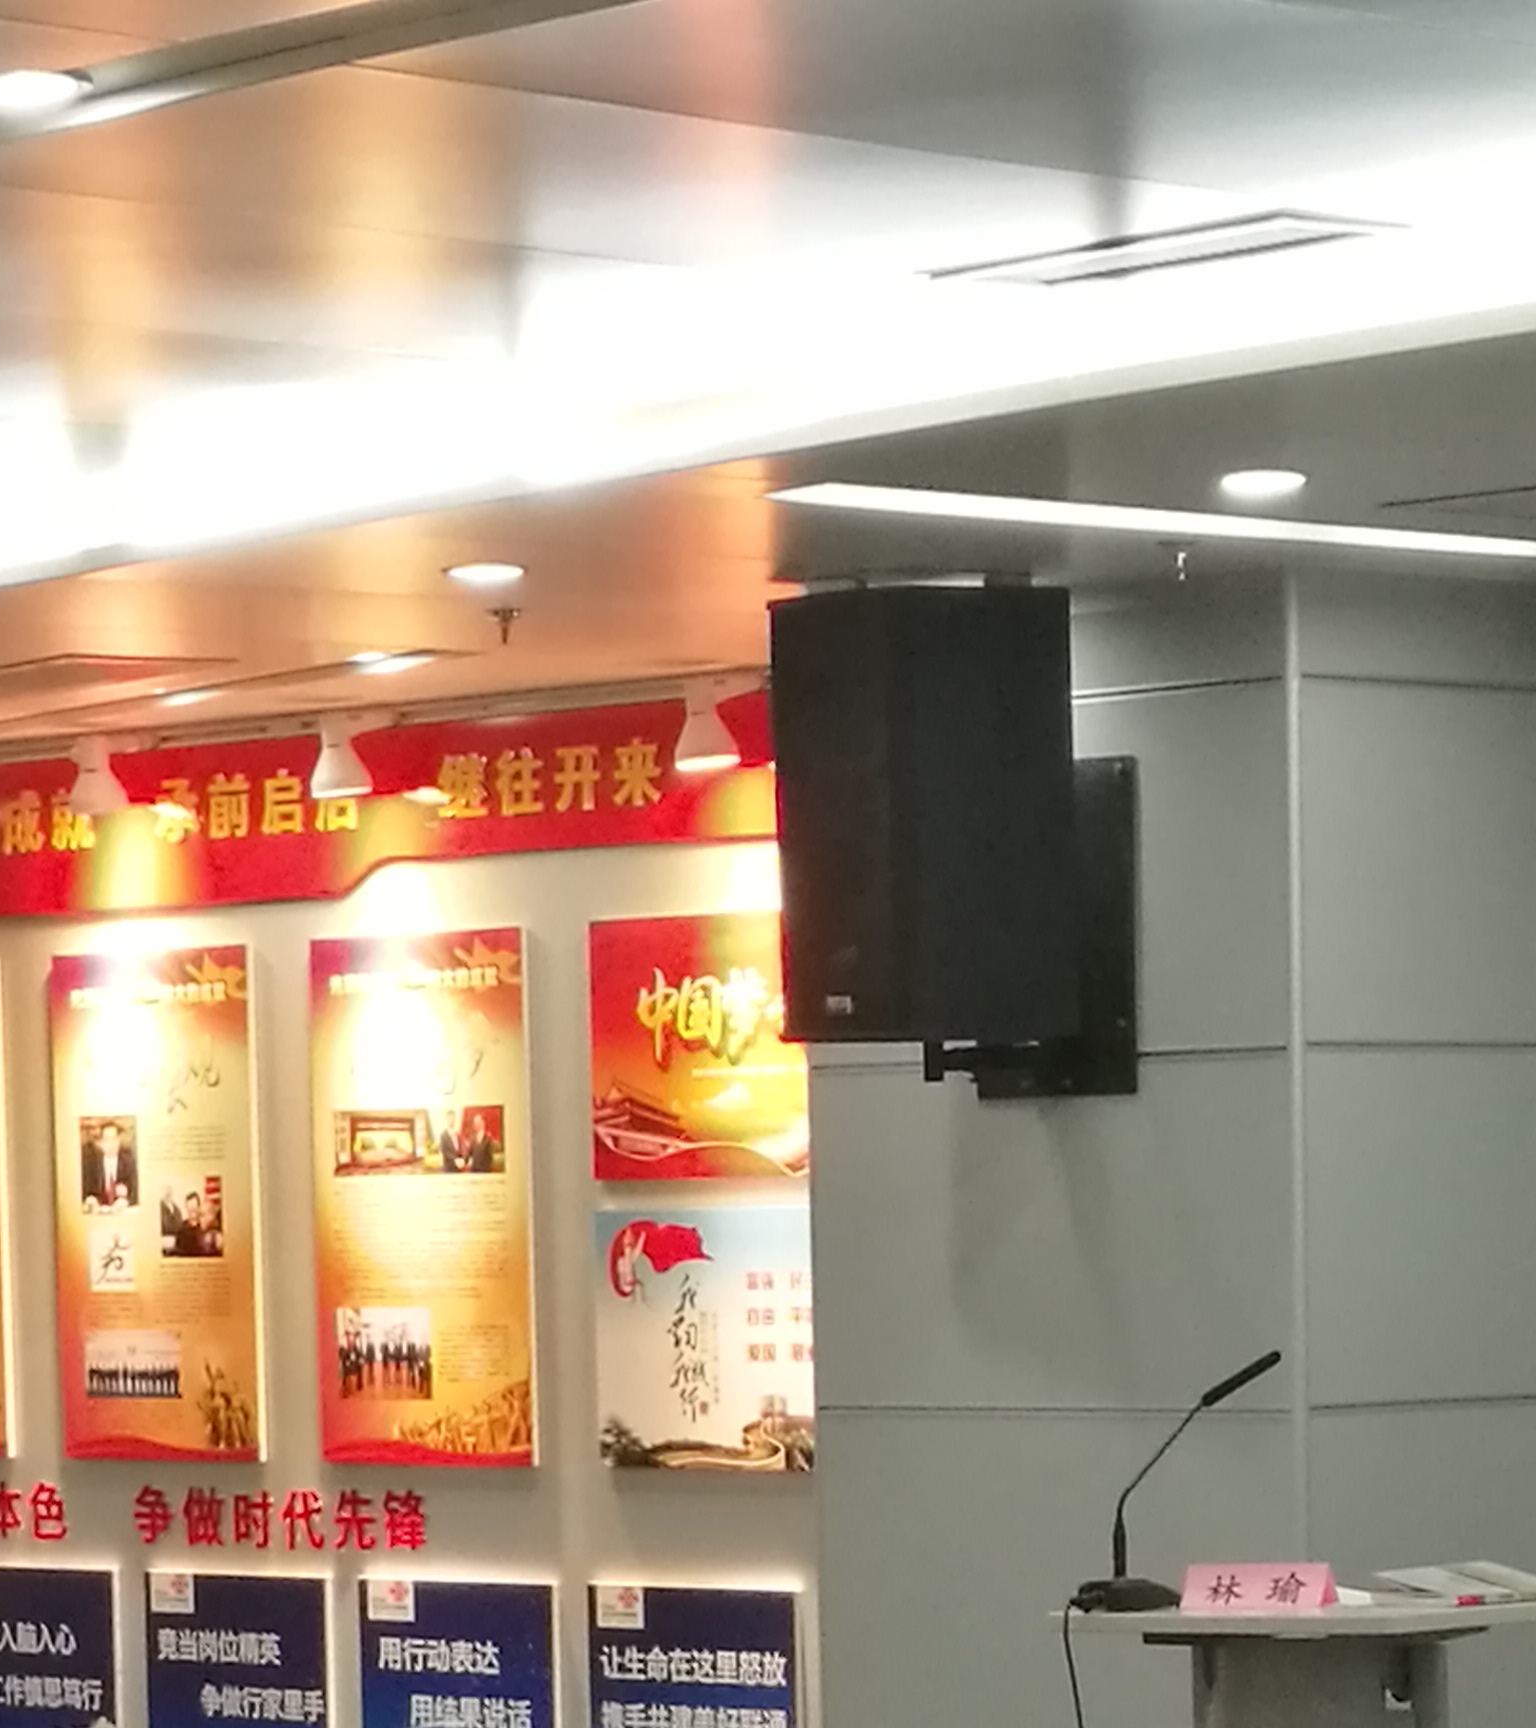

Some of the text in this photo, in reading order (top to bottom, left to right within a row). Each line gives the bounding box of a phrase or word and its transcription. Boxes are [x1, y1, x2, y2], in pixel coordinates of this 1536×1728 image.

[436, 737, 662, 818] 继往开来
[132, 1485, 428, 1552] 争做时代先锋
[157, 1627, 282, 1667] 竞当岗位精英
[378, 1636, 501, 1676] 用行动表达
[599, 1643, 788, 1688] 让生命在这里怒放
[199, 1683, 326, 1724] 争做行家里手
